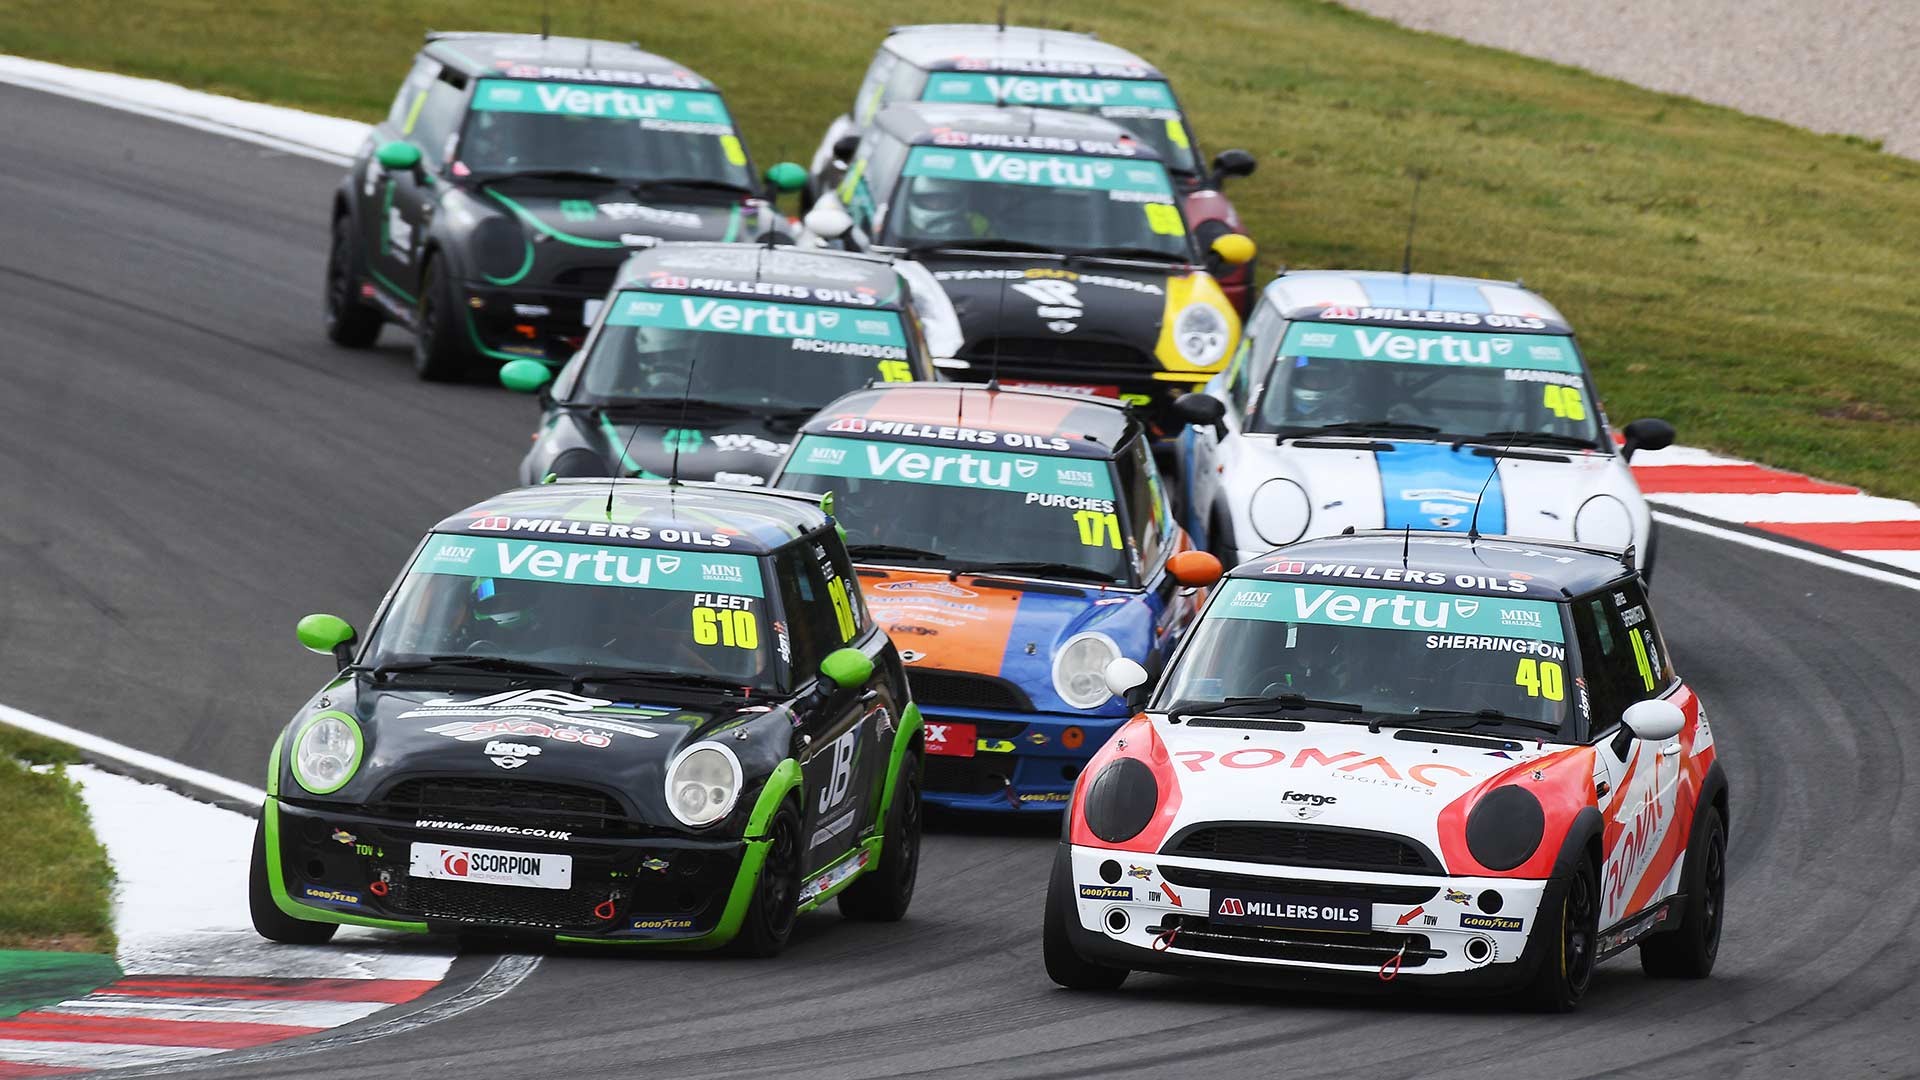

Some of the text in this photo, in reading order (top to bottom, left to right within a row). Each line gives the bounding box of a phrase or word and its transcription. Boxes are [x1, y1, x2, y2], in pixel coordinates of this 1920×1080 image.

[536, 85, 658, 117] Vertu
[984, 76, 1104, 103] Vertu
[970, 151, 1094, 187] Vertu
[690, 277, 876, 306] MILLERS OILS
[680, 298, 816, 338] Vertu
[1360, 307, 1546, 329] MILLERS OILS
[792, 338, 907, 361] RICHARDSON
[1355, 330, 1491, 363] Vertu
[878, 359, 913, 382] 15
[1544, 384, 1585, 420] 46
[868, 421, 1070, 451] MILLERS OILS
[866, 445, 1012, 488] Vertu
[1025, 492, 1115, 513] PURCHES
[512, 518, 731, 548] MILLERS OILS
[1073, 510, 1124, 550] 171
[438, 544, 475, 557] MINI
[497, 542, 649, 585] Vertu
[702, 564, 741, 576] MINI
[1307, 563, 1528, 593] MILLERS OILS
[693, 594, 753, 610] FLEET
[1233, 592, 1272, 604] MINI
[1294, 587, 1449, 629] Vertu
[1500, 609, 1541, 622] MINI
[691, 607, 758, 650] 610
[1426, 635, 1566, 661] SHERRINGTON
[1515, 658, 1564, 701] 40
[553, 723, 614, 738] TEAM
[819, 731, 854, 814] JB
[1175, 748, 1472, 787] ROMAC
[1331, 771, 1433, 796] LOGISTICS
[415, 820, 572, 840] WWW.JBEMC.CO.UK
[471, 853, 541, 876] SCORPION
[306, 888, 358, 904] GOODYEAR
[1081, 887, 1130, 898] GOODYEAR
[1148, 891, 1161, 902] TOW
[634, 919, 692, 929] GOODYEAR
[1247, 902, 1359, 921] MILLERS OILS
[1424, 915, 1438, 926] TOW
[1464, 917, 1520, 929] GOODYEAR
